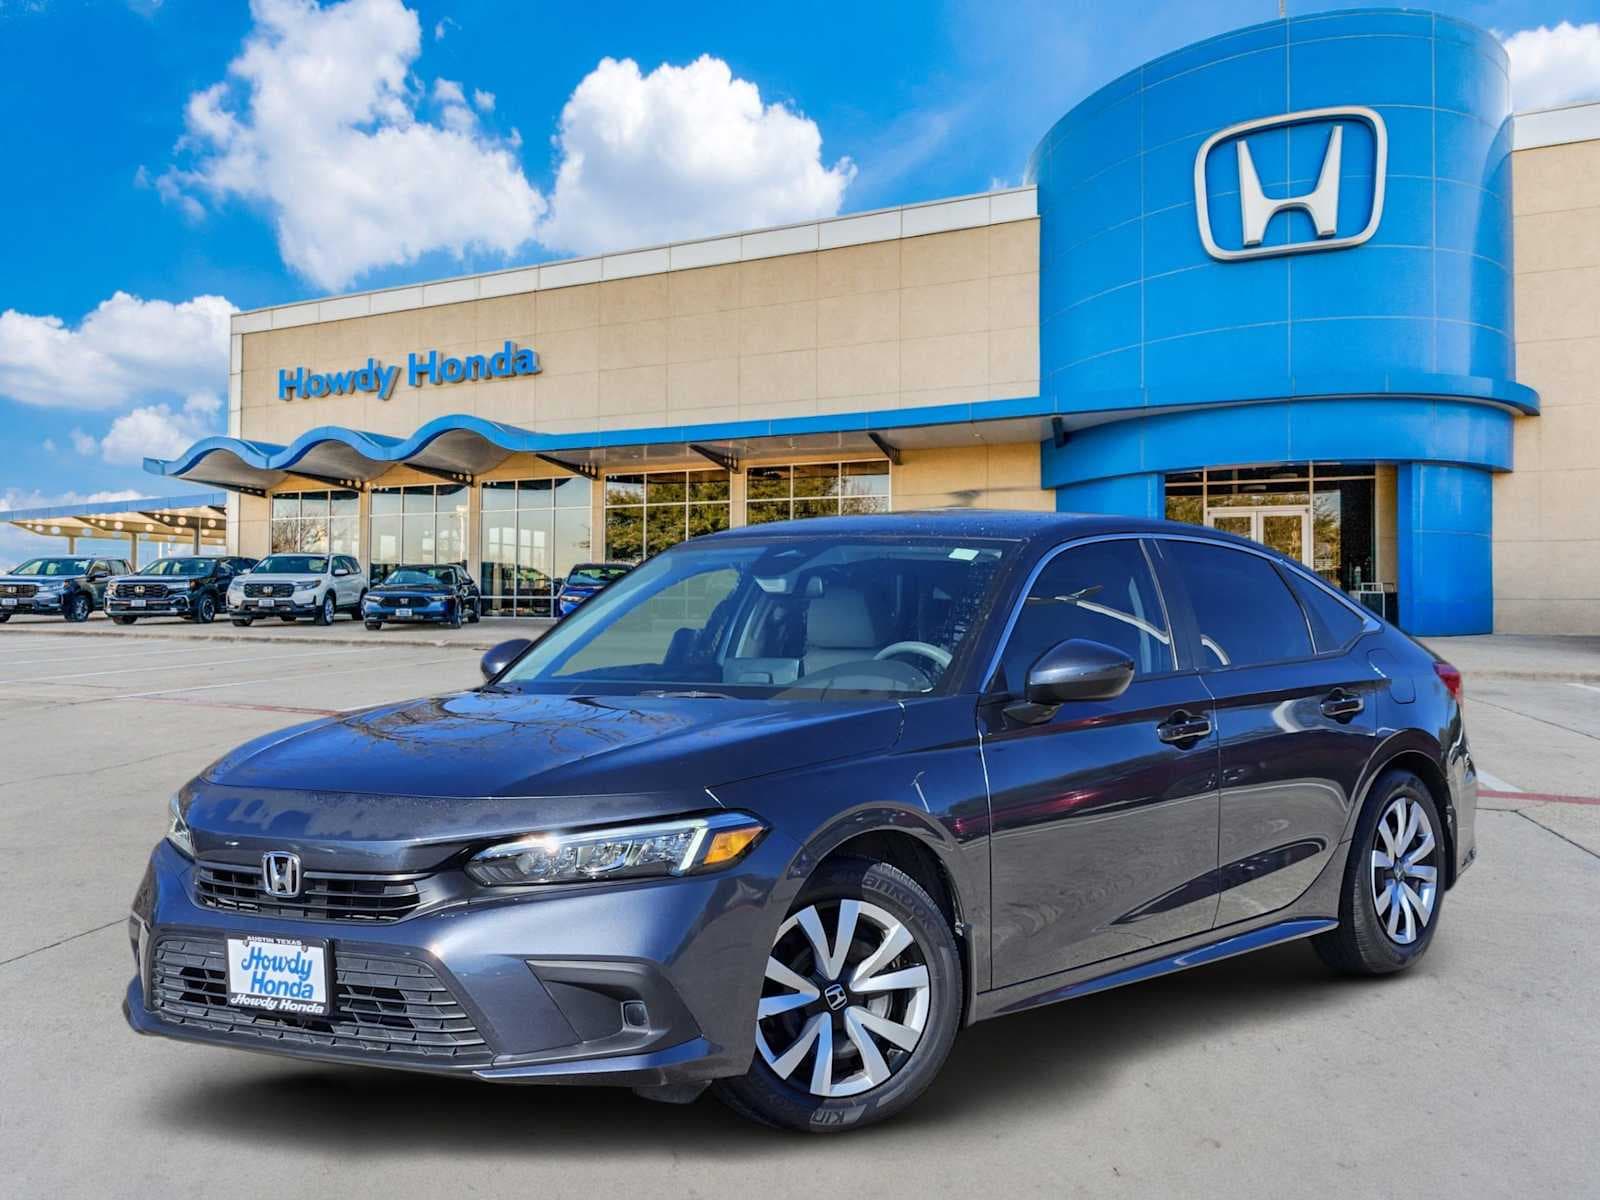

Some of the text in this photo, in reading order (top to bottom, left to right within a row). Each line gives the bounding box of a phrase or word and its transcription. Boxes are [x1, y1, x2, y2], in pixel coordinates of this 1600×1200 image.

[278, 340, 542, 401] Howdy Honda
[276, 938, 302, 946] TEXAS
[241, 946, 313, 981] Howdy
[250, 971, 314, 999] Honda
[230, 994, 325, 1014] Howdy Honda
